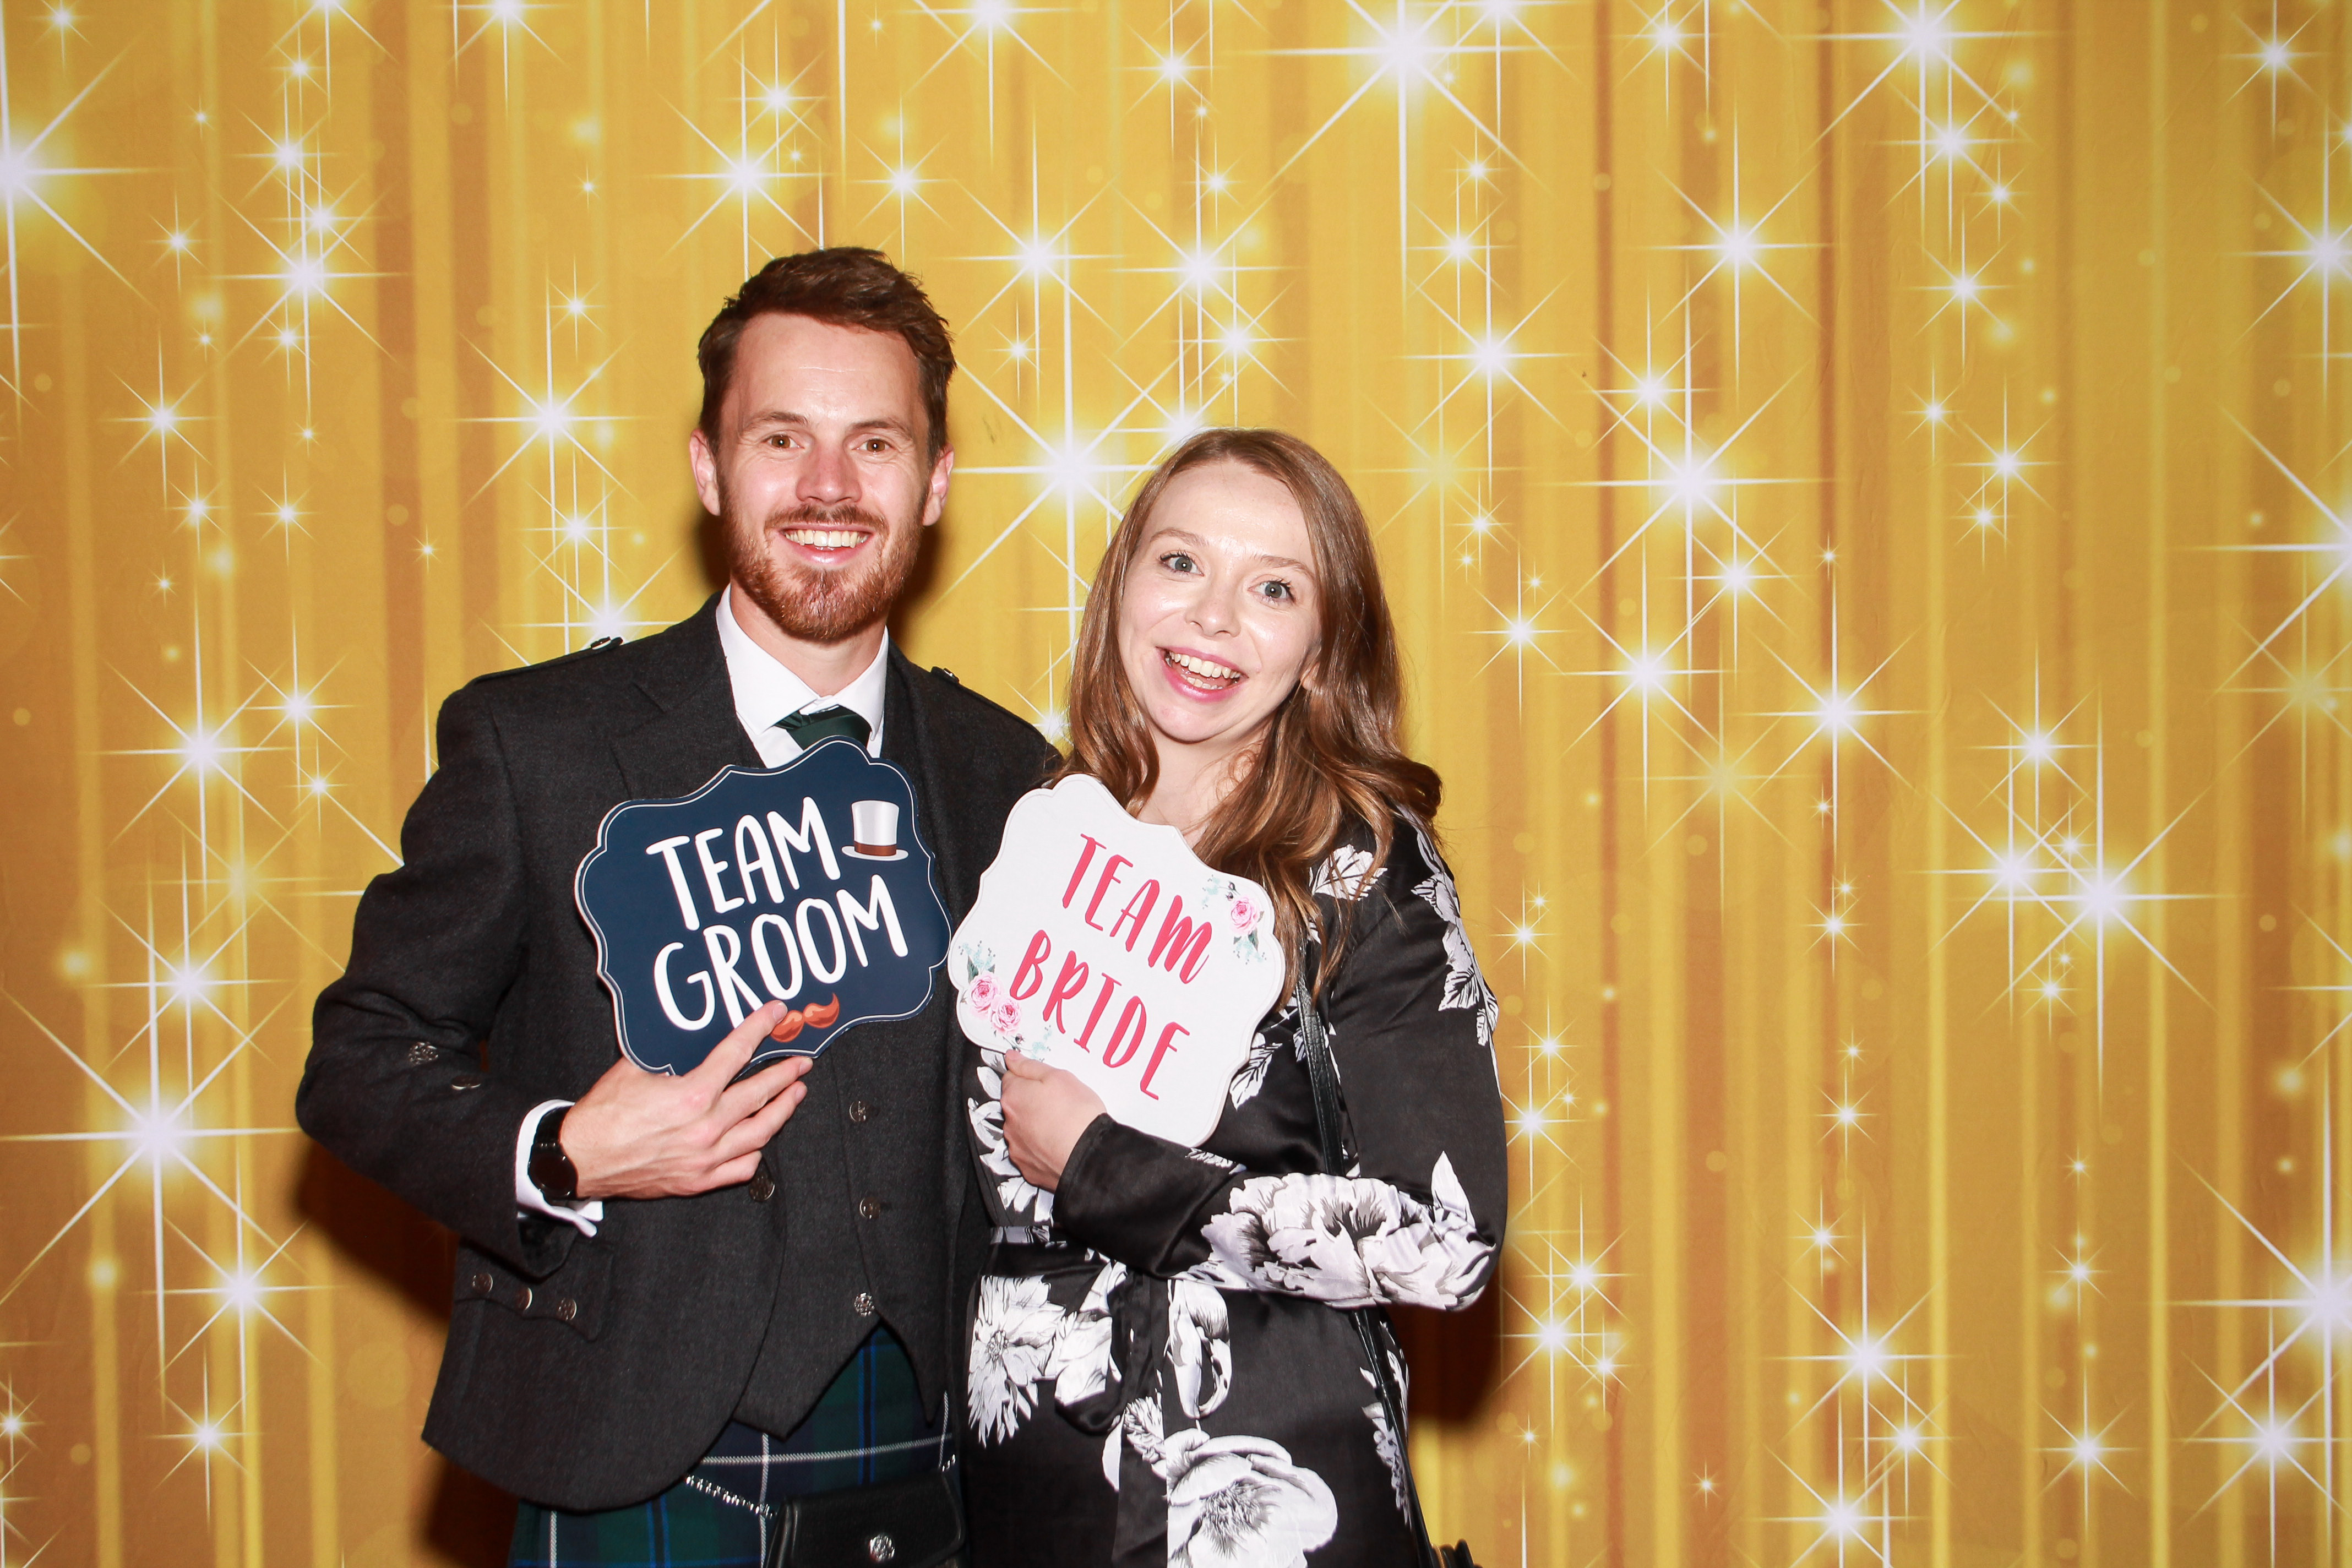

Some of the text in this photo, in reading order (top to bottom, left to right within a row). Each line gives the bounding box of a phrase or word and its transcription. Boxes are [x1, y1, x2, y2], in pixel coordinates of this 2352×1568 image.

[646, 797, 841, 931] TEAM
[1061, 833, 1212, 984] TEAM
[654, 874, 908, 1031] GROOM
[1009, 929, 1190, 1101] BRIDE
